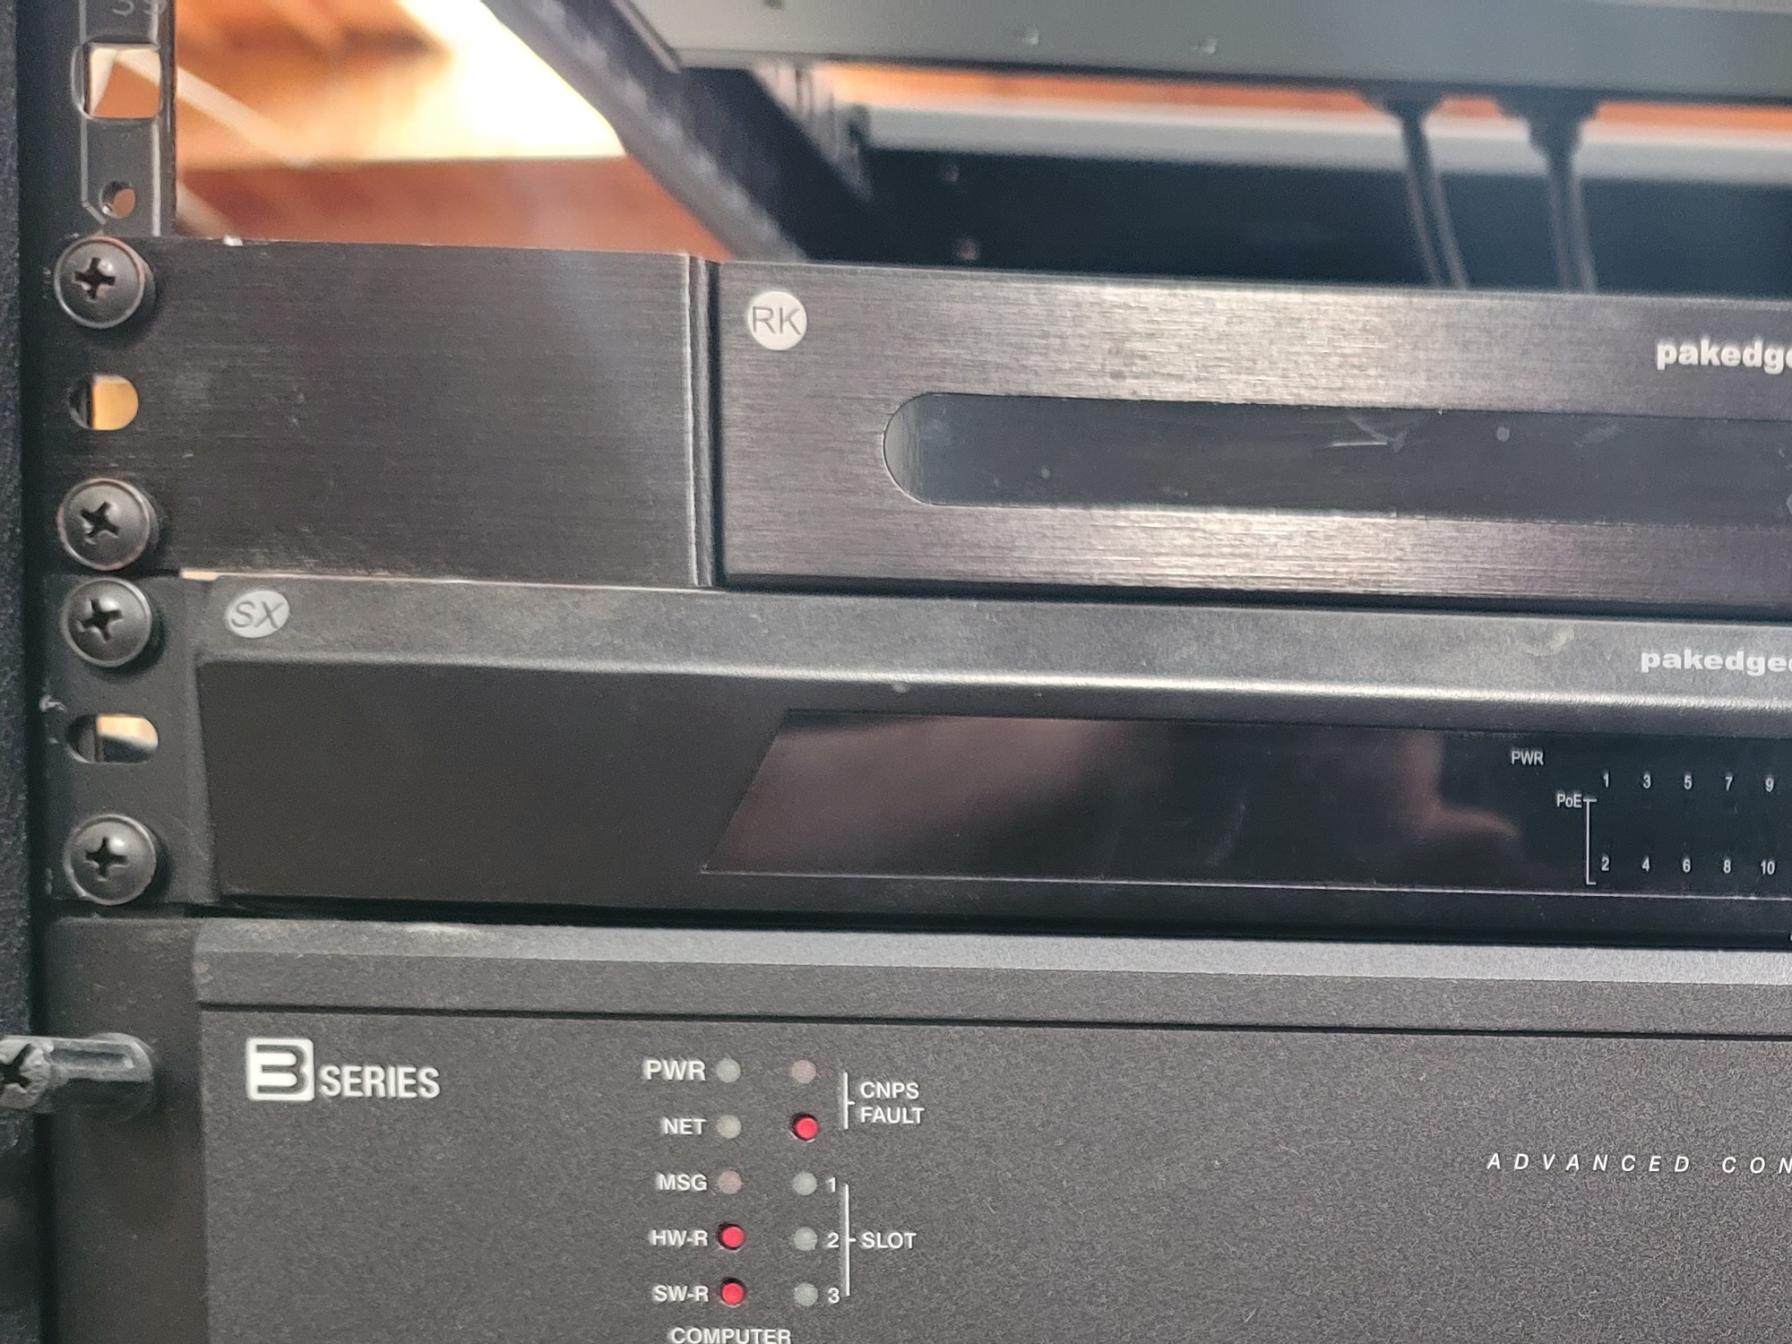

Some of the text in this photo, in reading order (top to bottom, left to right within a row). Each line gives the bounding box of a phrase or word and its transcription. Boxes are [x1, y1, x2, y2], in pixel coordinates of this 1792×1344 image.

[752, 305, 801, 335] RK
[230, 600, 285, 629] SX
[1511, 750, 1544, 766] PWR
[1603, 772, 1609, 788] 1
[1643, 773, 1651, 789] 3
[1684, 774, 1693, 790] 5
[1725, 775, 1733, 791] 7
[1765, 777, 1775, 793] 9
[1556, 792, 1582, 808] PoE
[1601, 855, 1610, 872] 2
[1641, 857, 1650, 872] 4
[1682, 858, 1691, 873] 6
[1723, 858, 1732, 874] 8
[1760, 860, 1776, 875] 10
[249, 1040, 440, 1099] 3 SERIES
[643, 1059, 706, 1081] PWR
[859, 1081, 920, 1100] CNPS
[860, 1105, 925, 1124] FAULT
[661, 1117, 707, 1135] NET
[1486, 1152, 1690, 1173] ADVANCED
[656, 1173, 707, 1192] MSG
[825, 1176, 836, 1193] 1
[649, 1229, 708, 1248] HW-R
[826, 1231, 840, 1249] 2
[861, 1231, 917, 1249] SLOT
[652, 1284, 709, 1302] SW-R
[827, 1287, 840, 1304] 3
